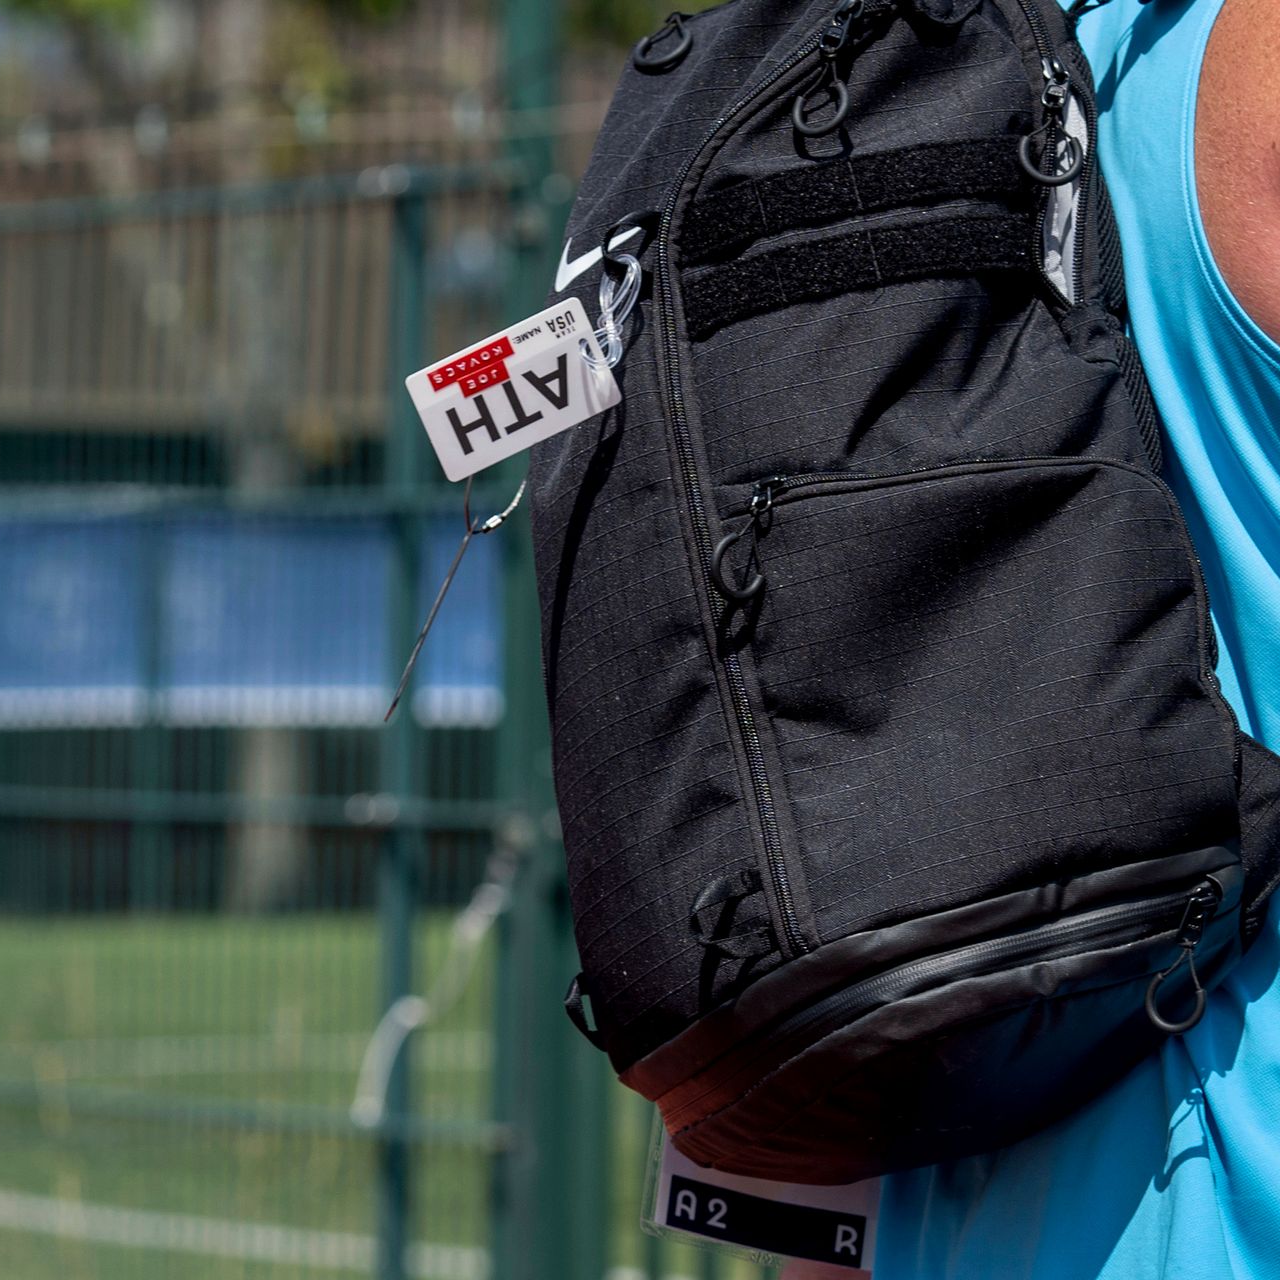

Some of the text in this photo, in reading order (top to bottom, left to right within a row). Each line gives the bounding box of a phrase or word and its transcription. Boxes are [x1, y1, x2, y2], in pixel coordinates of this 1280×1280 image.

[513, 326, 542, 345] NAME:
[545, 310, 576, 333] USA
[433, 345, 503, 383] KOVACS
[467, 369, 499, 389] JOE
[446, 353, 568, 455] ATH
[834, 1224, 858, 1257] R
